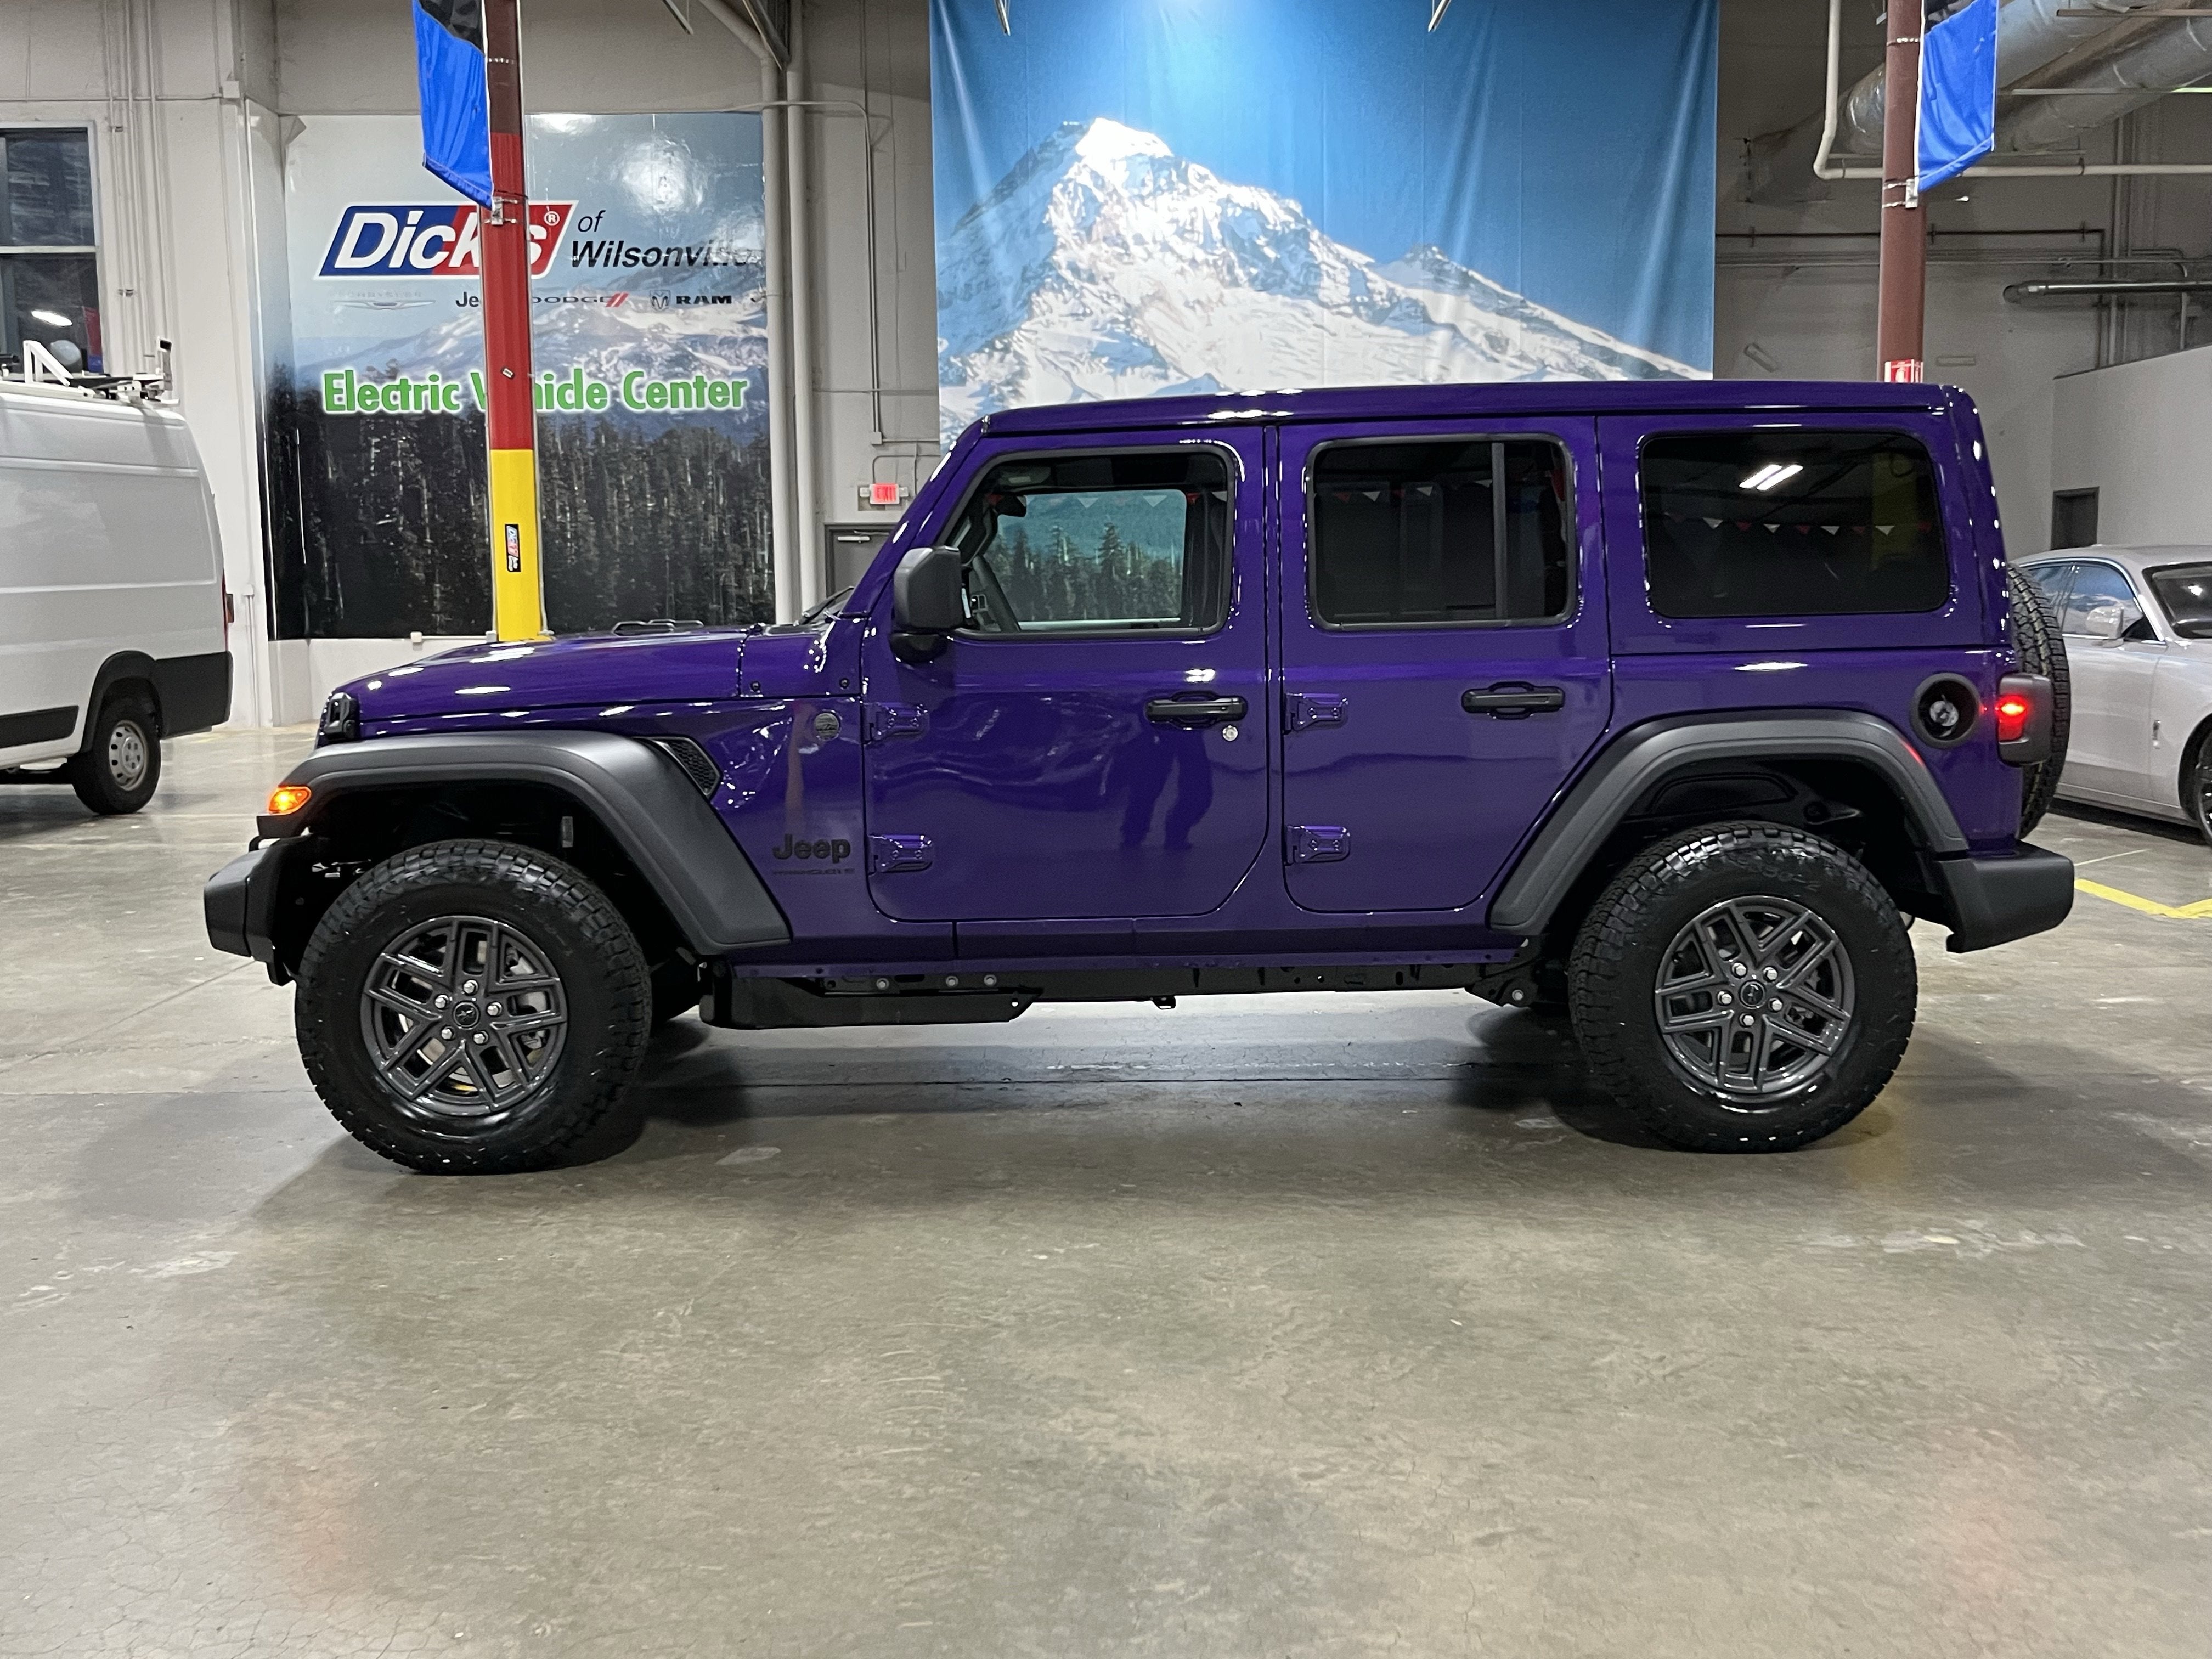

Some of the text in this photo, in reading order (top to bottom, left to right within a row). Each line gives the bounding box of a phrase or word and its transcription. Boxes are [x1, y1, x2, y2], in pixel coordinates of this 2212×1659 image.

[578, 210, 606, 232] of
[455, 291, 479, 307] Je
[676, 295, 732, 304] RAM
[324, 370, 460, 411] Electric
[624, 371, 748, 409] Center
[877, 487, 896, 501] EXIT
[772, 833, 850, 864] Jeep
